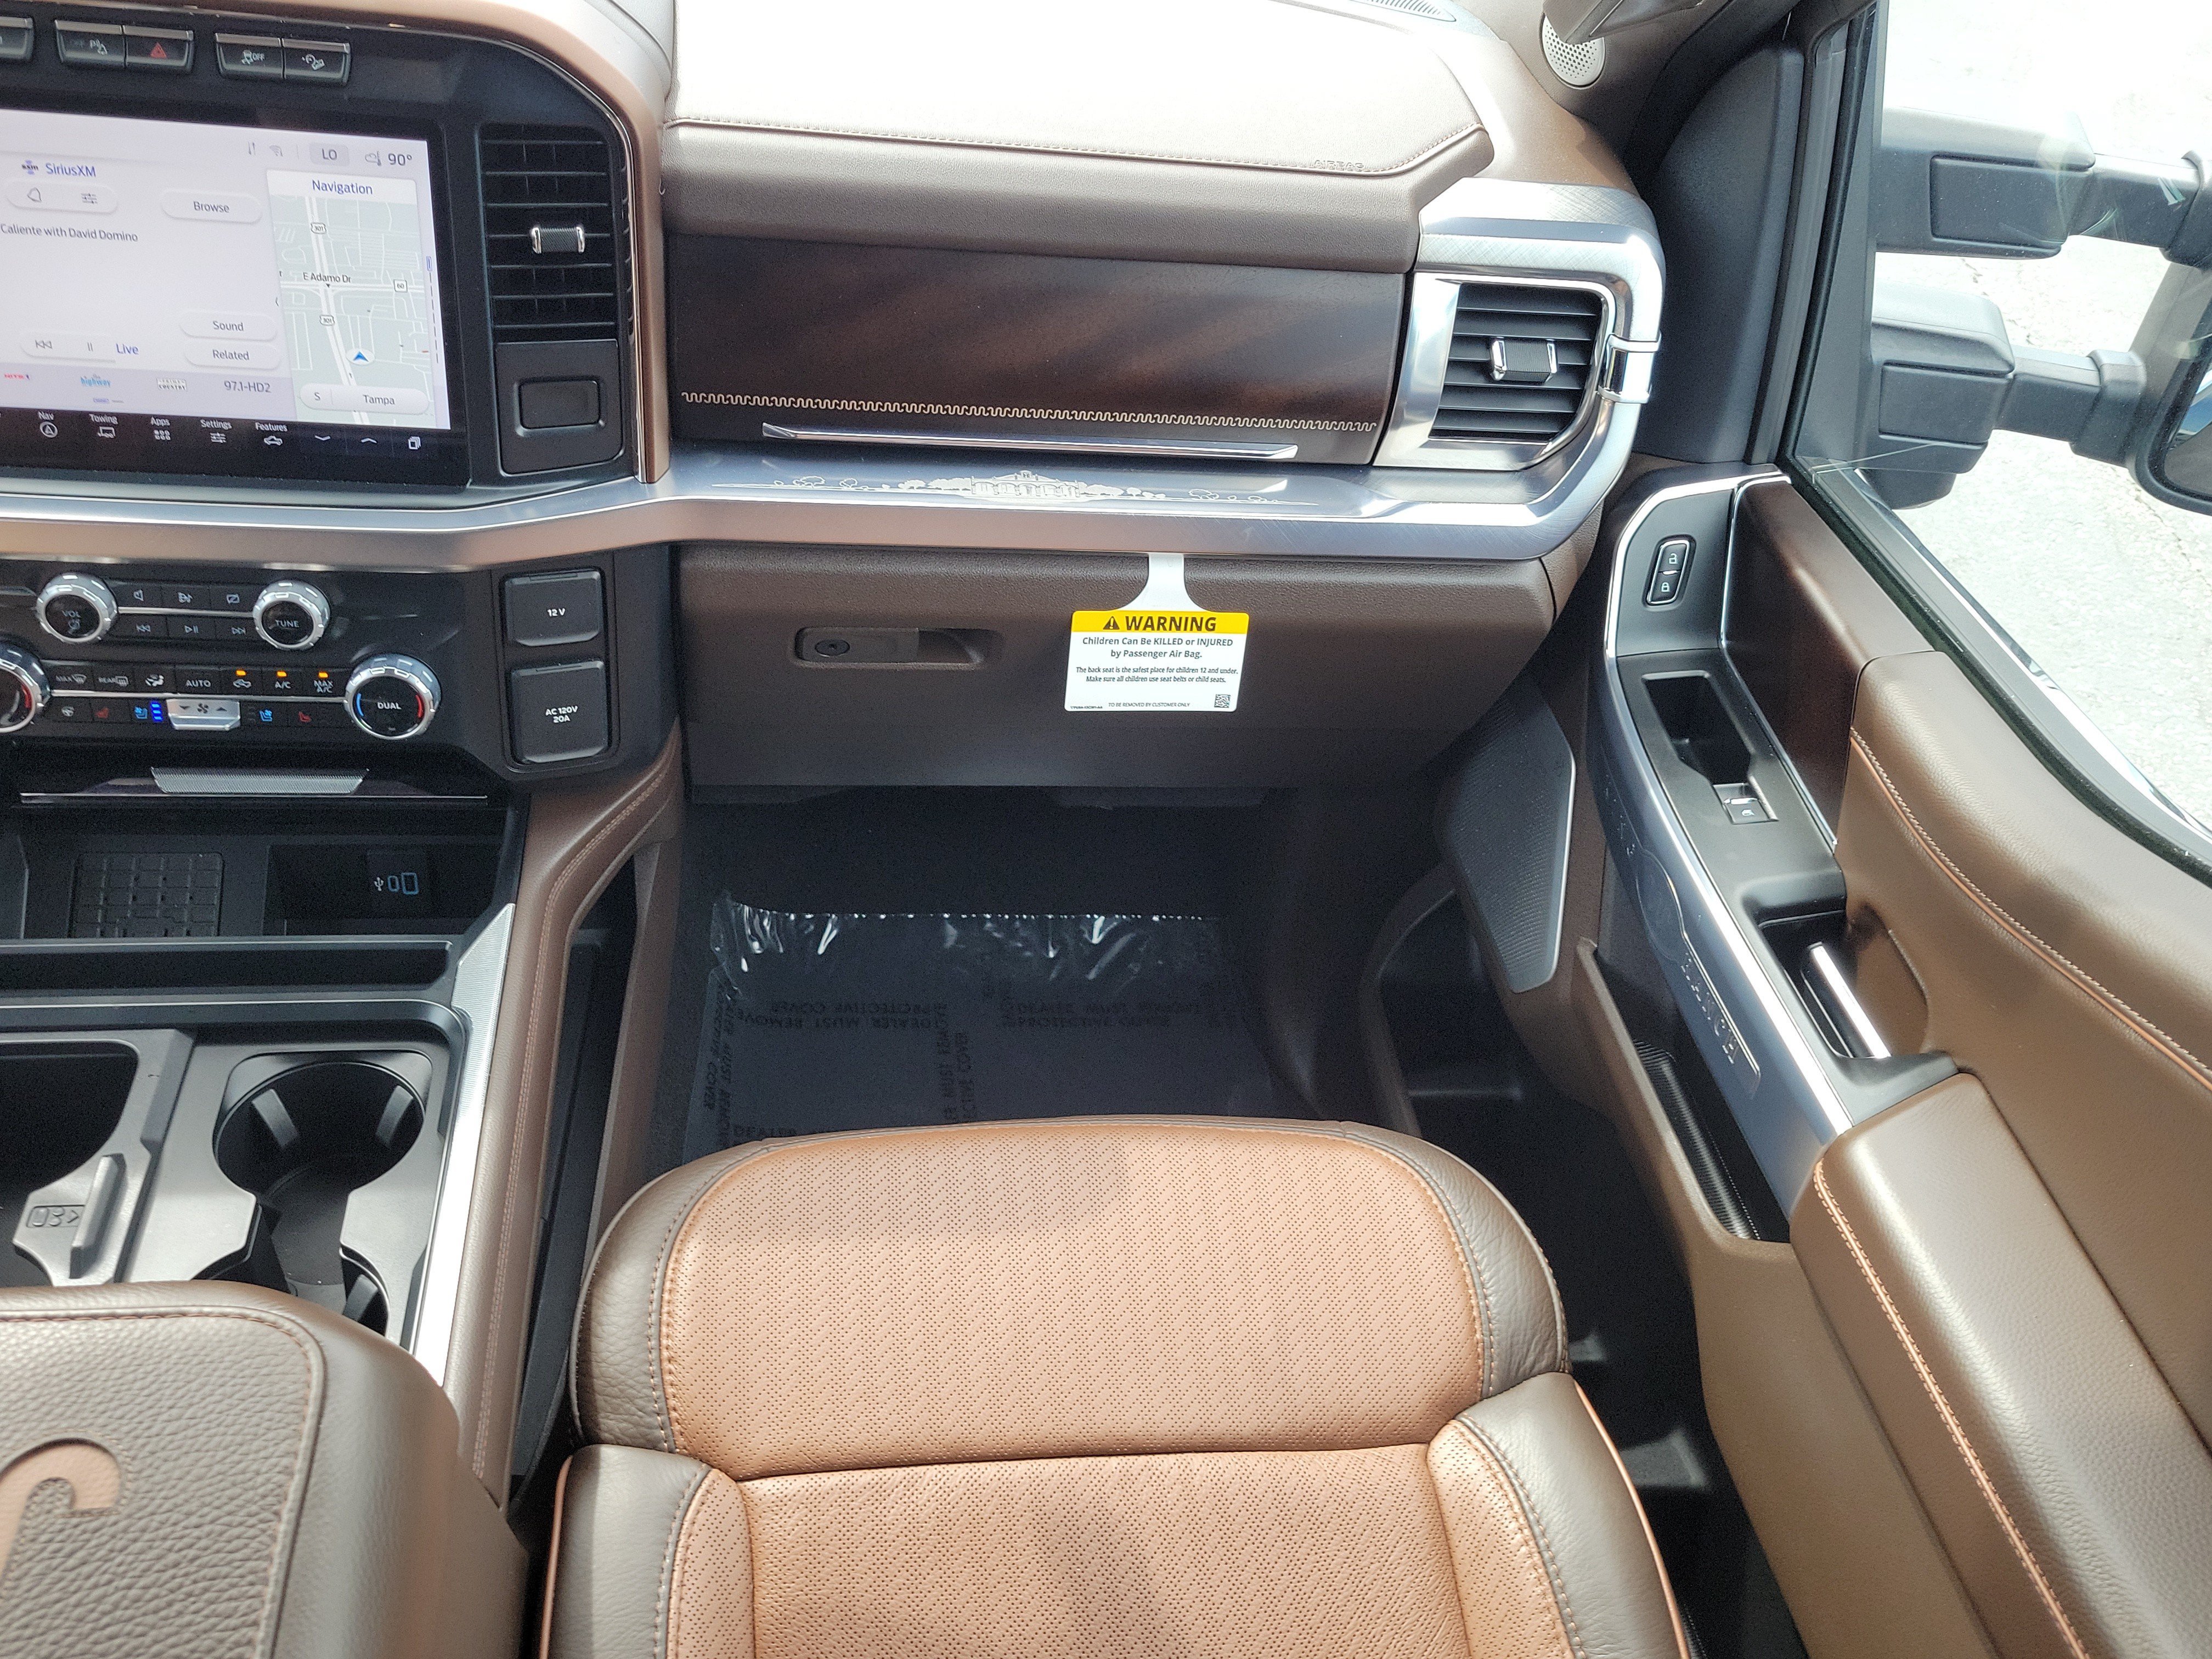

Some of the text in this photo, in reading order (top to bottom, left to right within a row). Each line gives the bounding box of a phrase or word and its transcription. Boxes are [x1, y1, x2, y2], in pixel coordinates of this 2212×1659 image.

[322, 148, 337, 161] LO
[388, 153, 413, 166] 90°
[46, 162, 96, 177] SiriusXM
[1314, 160, 1364, 169] AIRBAG
[312, 179, 373, 195] Navigation
[193, 200, 230, 213] Browse
[1, 223, 138, 242] Caliente with David Domino
[303, 272, 352, 283] E Adamo Dr
[213, 320, 244, 331] Sound
[116, 343, 139, 355] Live
[212, 349, 250, 362] Related
[224, 380, 272, 393] 97.1-HD2
[314, 392, 321, 401] S
[363, 394, 396, 406] Tampa
[38, 411, 54, 420] Nav
[89, 414, 118, 425] Towing
[150, 416, 170, 427] Apps
[201, 419, 232, 430] Settings
[256, 422, 288, 433] Features
[558, 608, 566, 616] V
[275, 619, 299, 628] TUNE
[1125, 616, 1217, 631] WARNING
[1197, 639, 1233, 647] INJURED
[1111, 650, 1121, 658] by
[1124, 650, 1167, 659] Passenger
[1184, 651, 1202, 659] Bag.
[558, 706, 578, 714] 120V
[553, 715, 570, 723] 20A
